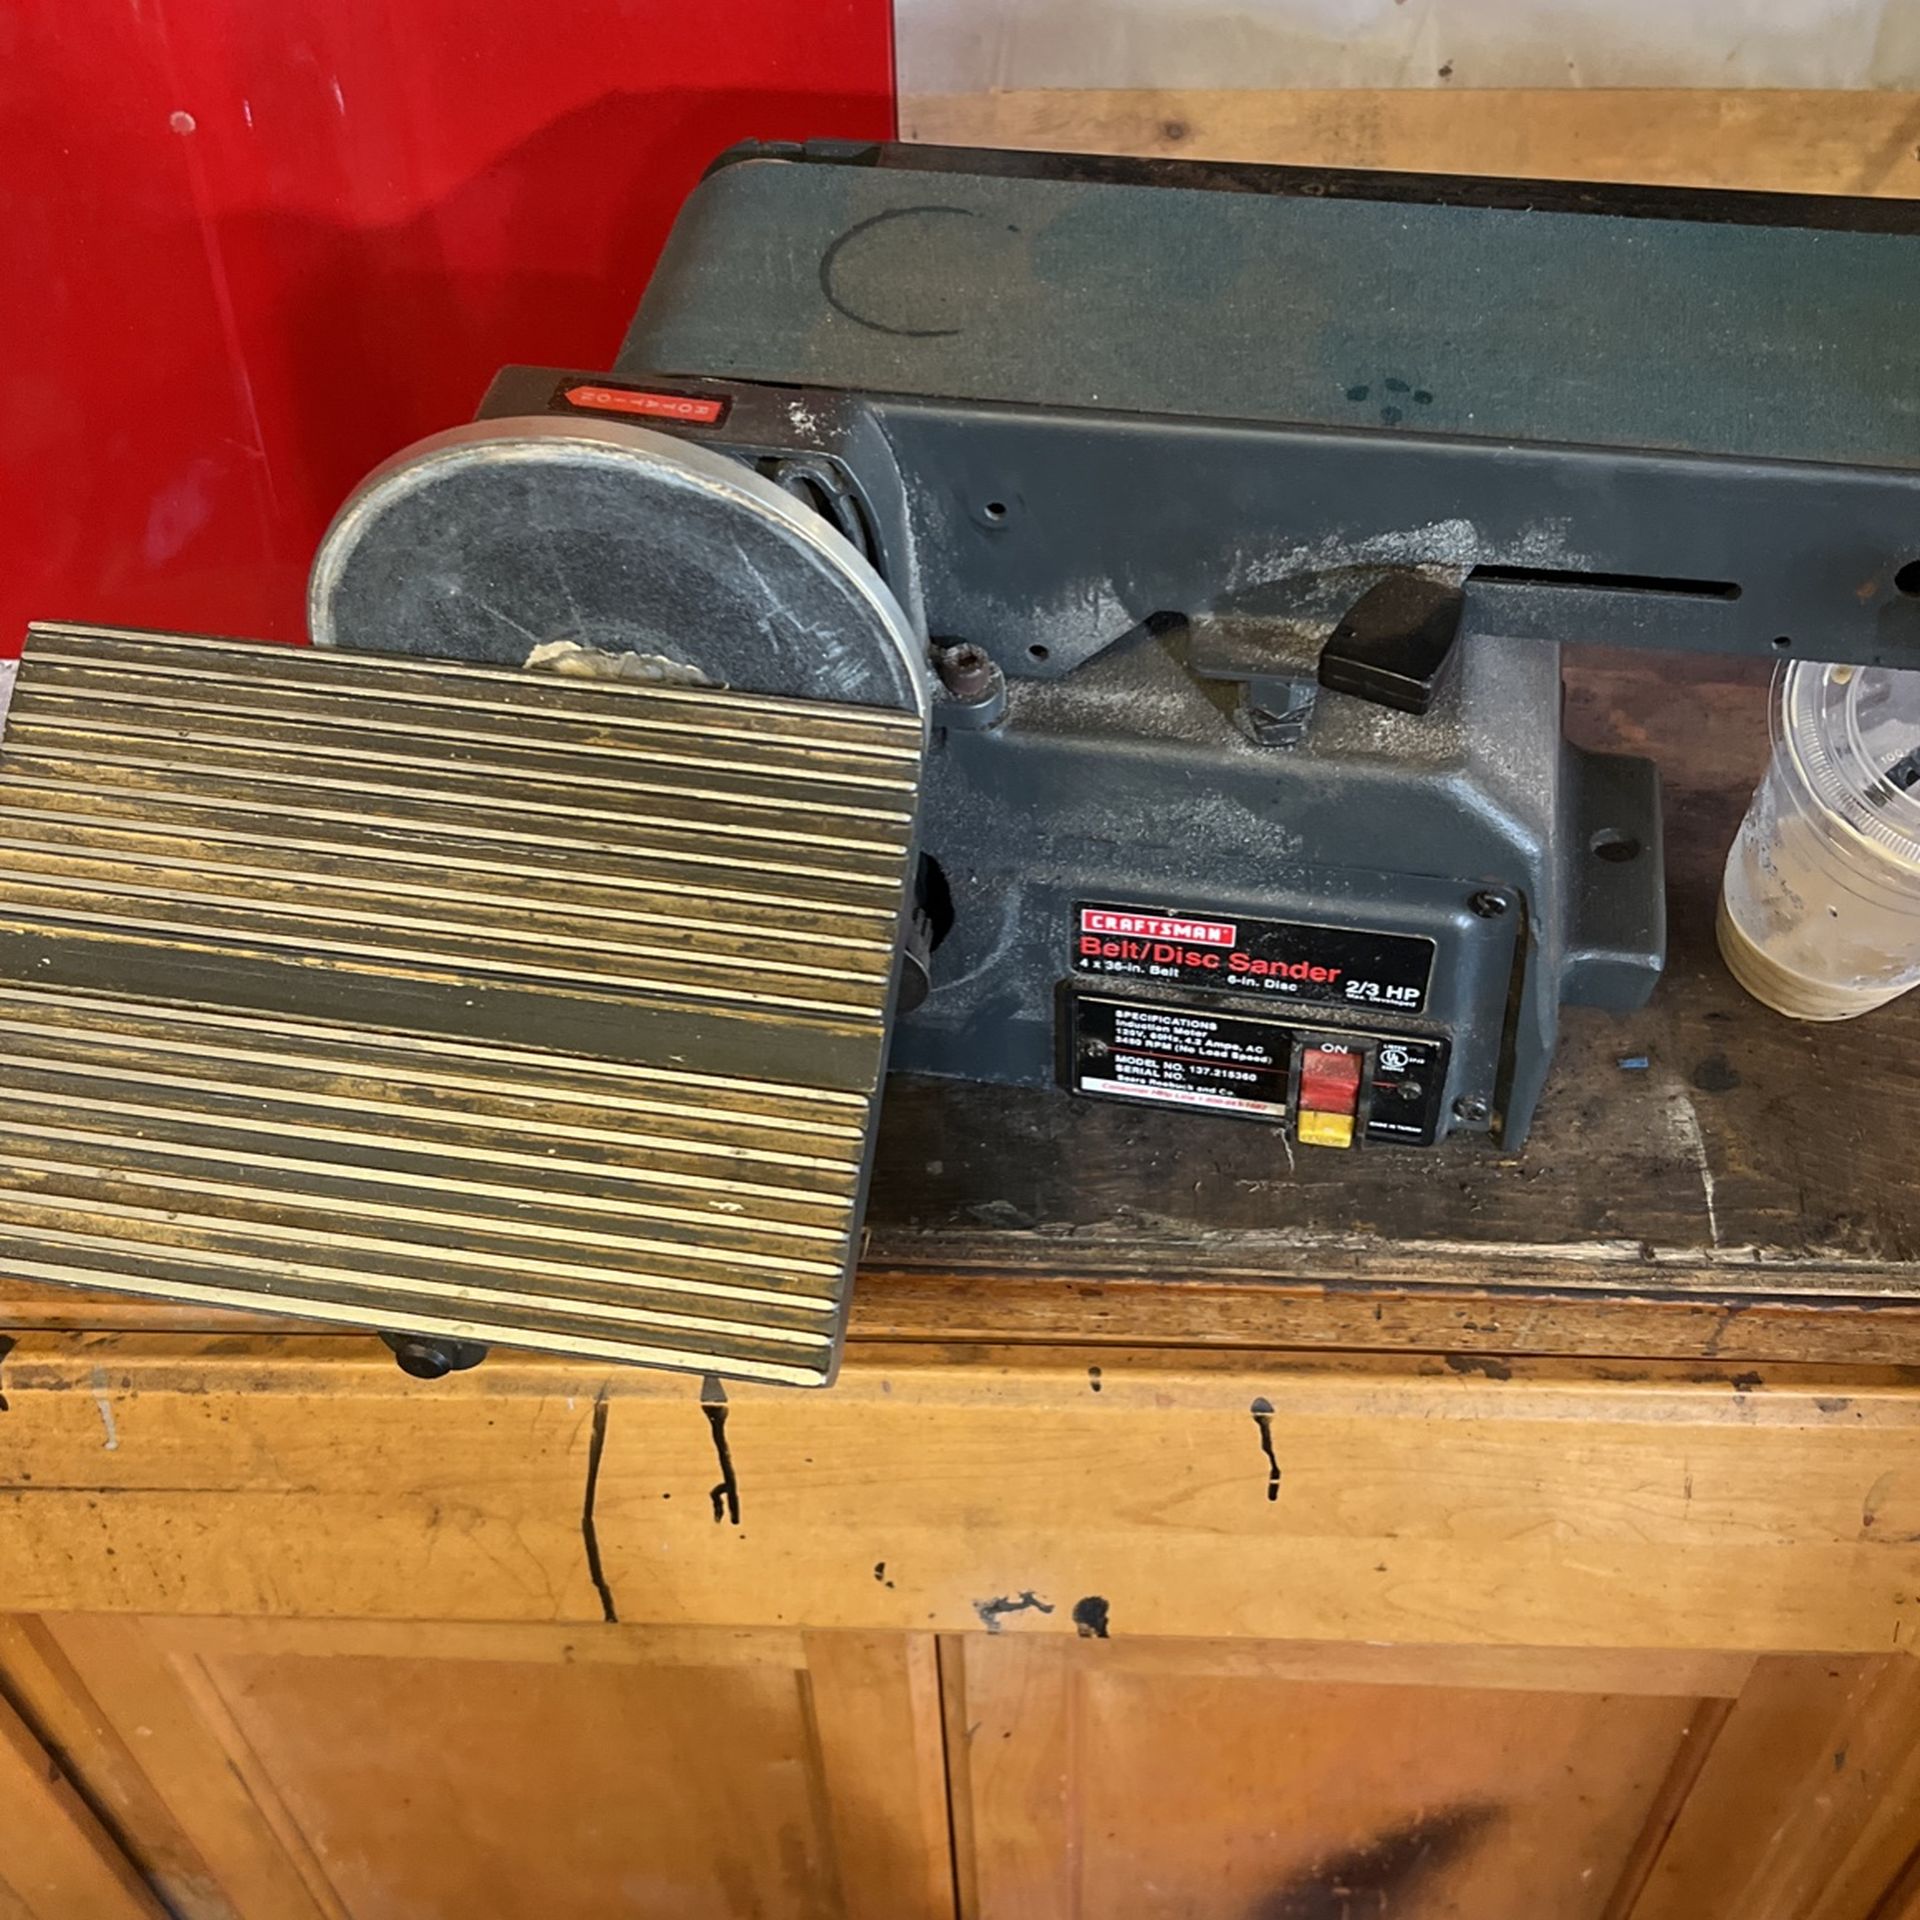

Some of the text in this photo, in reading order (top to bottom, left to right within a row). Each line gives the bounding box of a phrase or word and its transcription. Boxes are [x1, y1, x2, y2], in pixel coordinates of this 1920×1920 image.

[578, 393, 710, 415] ROTATION
[1091, 914, 1222, 942] CRAFTSMAN
[1080, 936, 1342, 983] Belt/Disc Sander
[1080, 958, 1089, 967] 4
[1105, 960, 1145, 974] 36-in.
[1150, 965, 1180, 978] Belt
[1227, 975, 1297, 992] 6-in. Disc
[1345, 980, 1421, 1001] 2/3 HP
[1115, 1009, 1218, 1031] SPECIFICATIONS
[1115, 1019, 1208, 1038] Induction Motor
[1145, 1040, 1172, 1050] RPM
[1245, 1045, 1265, 1054] AC
[1321, 1043, 1348, 1054] ON
[1115, 1054, 1160, 1069] MODEL
[1163, 1061, 1185, 1072] NO.
[1115, 1064, 1186, 1081] SERIAL NO.
